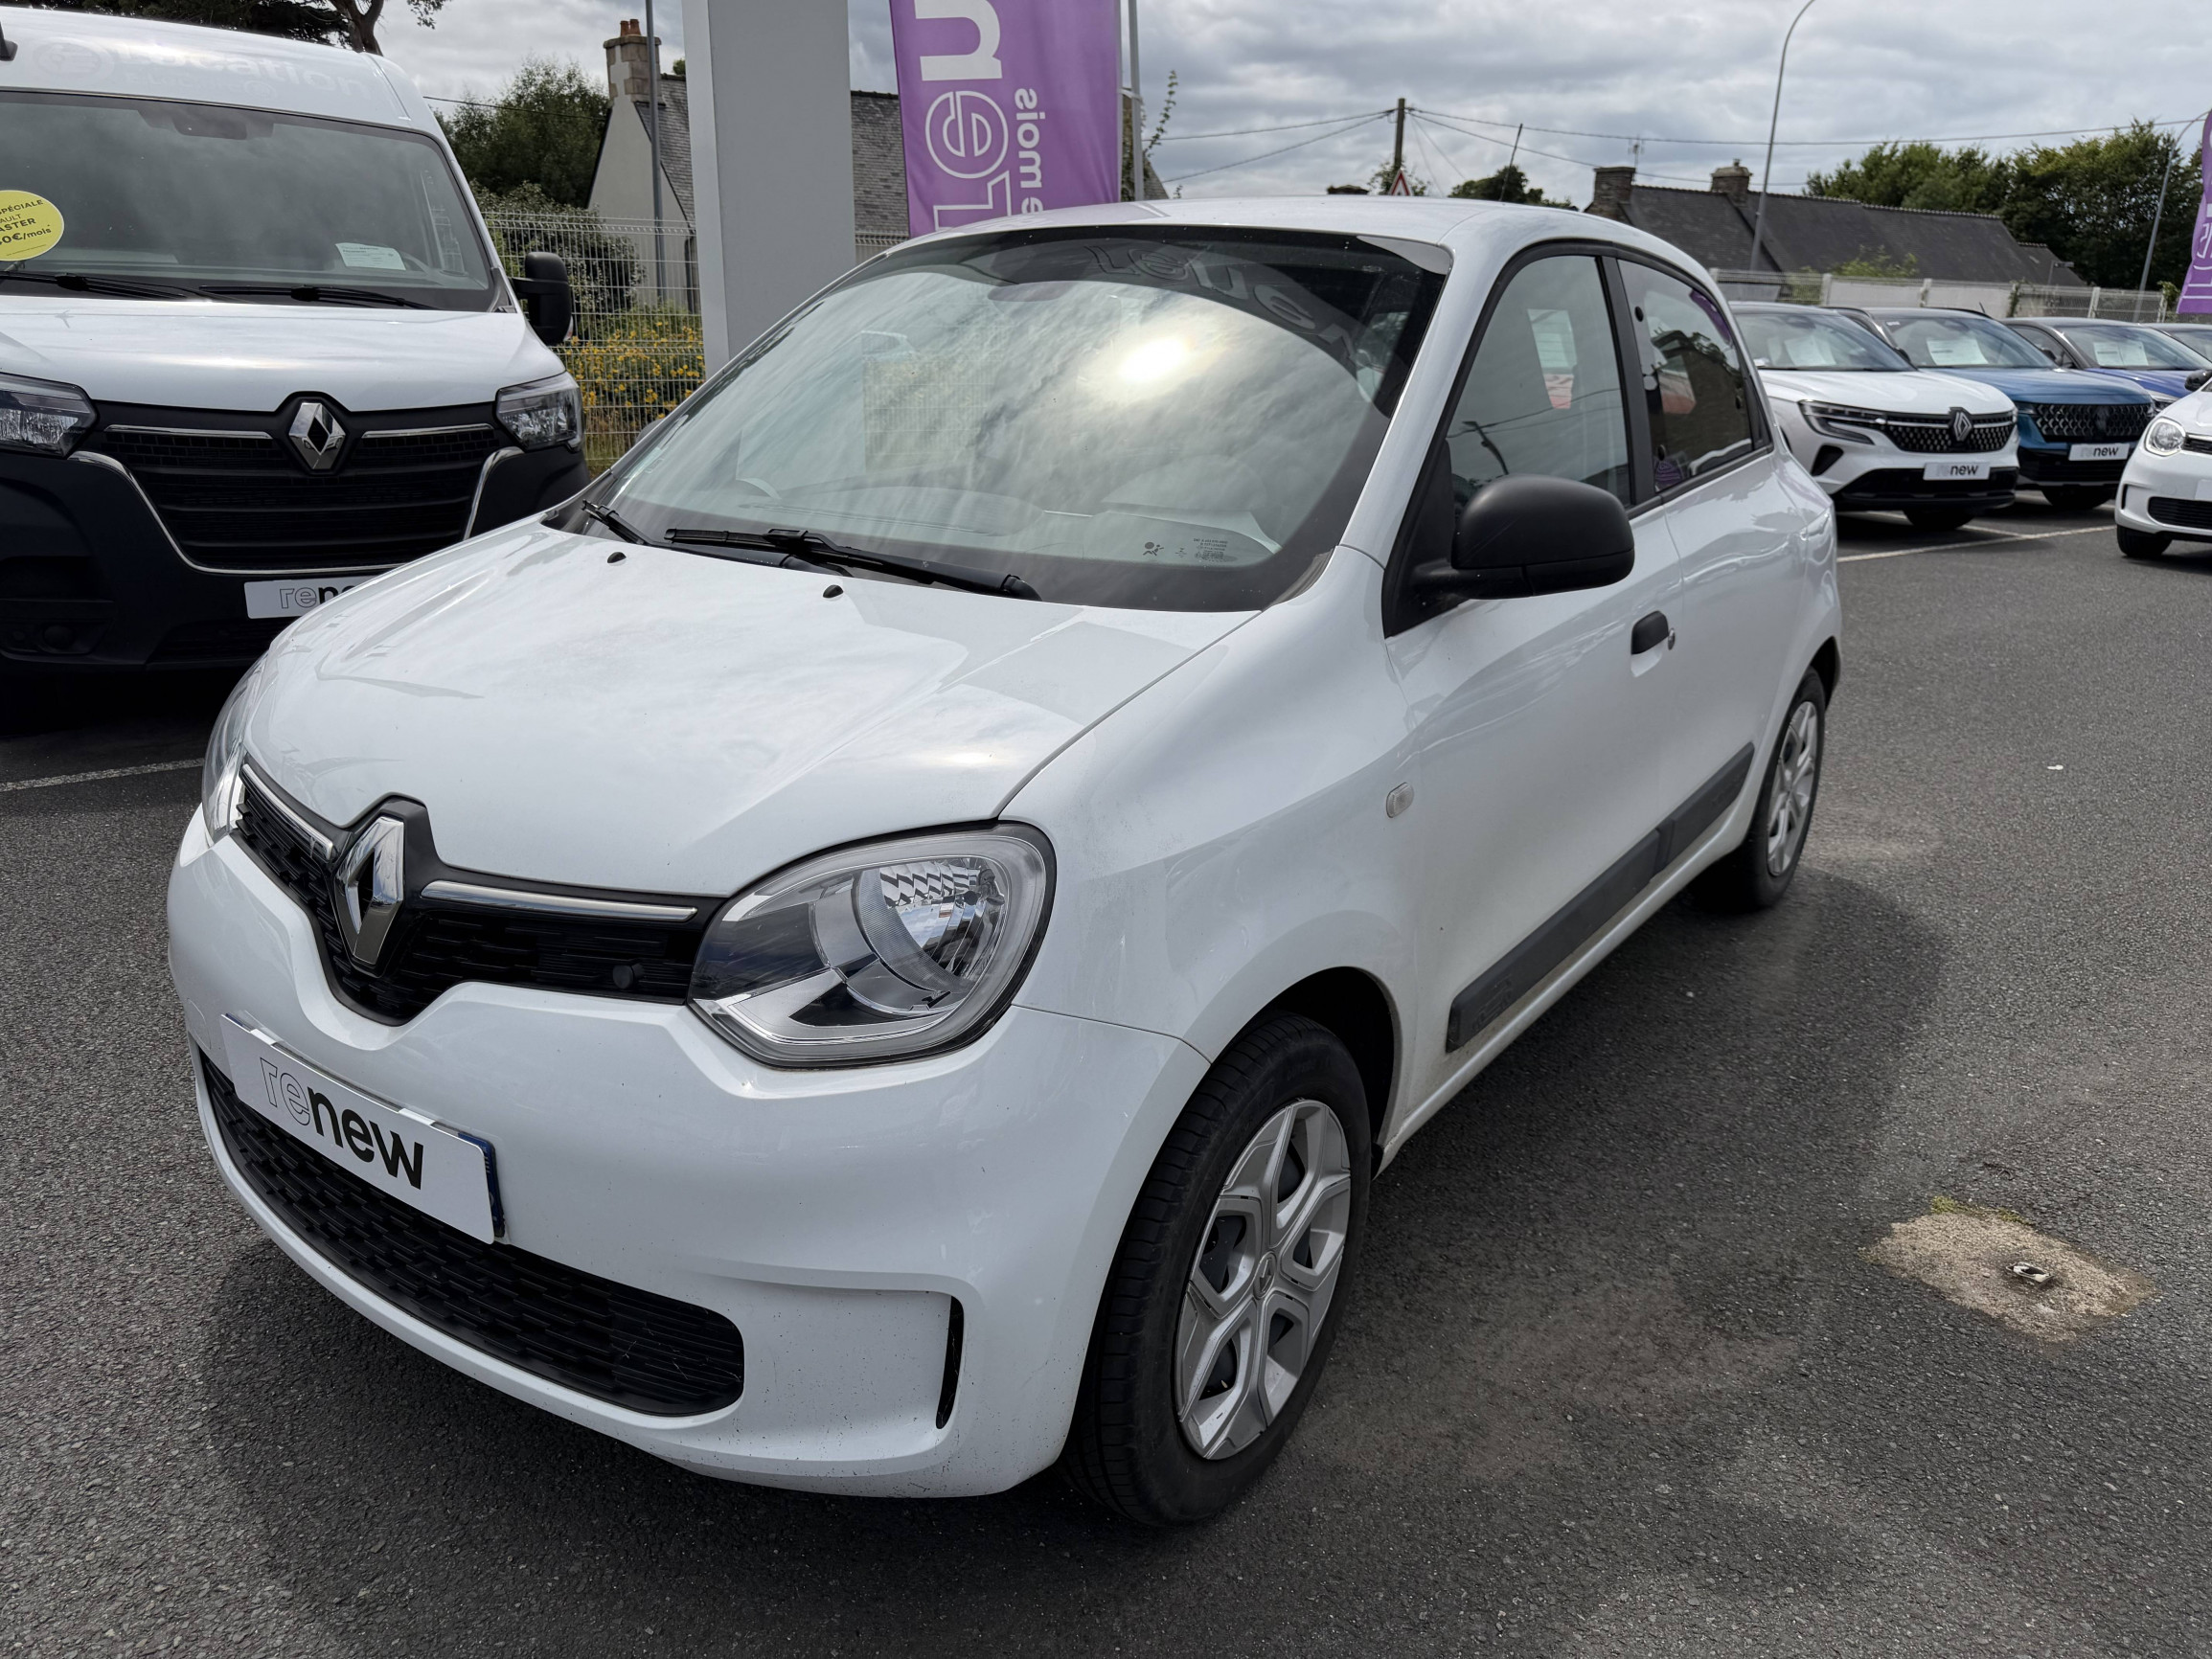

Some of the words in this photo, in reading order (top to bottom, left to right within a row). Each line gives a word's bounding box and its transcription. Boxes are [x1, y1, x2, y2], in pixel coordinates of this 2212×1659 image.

[0, 213, 21, 223] AULT
[0, 217, 36, 232] ASTER
[280, 585, 355, 609] ren
[260, 1057, 423, 1191] renew
